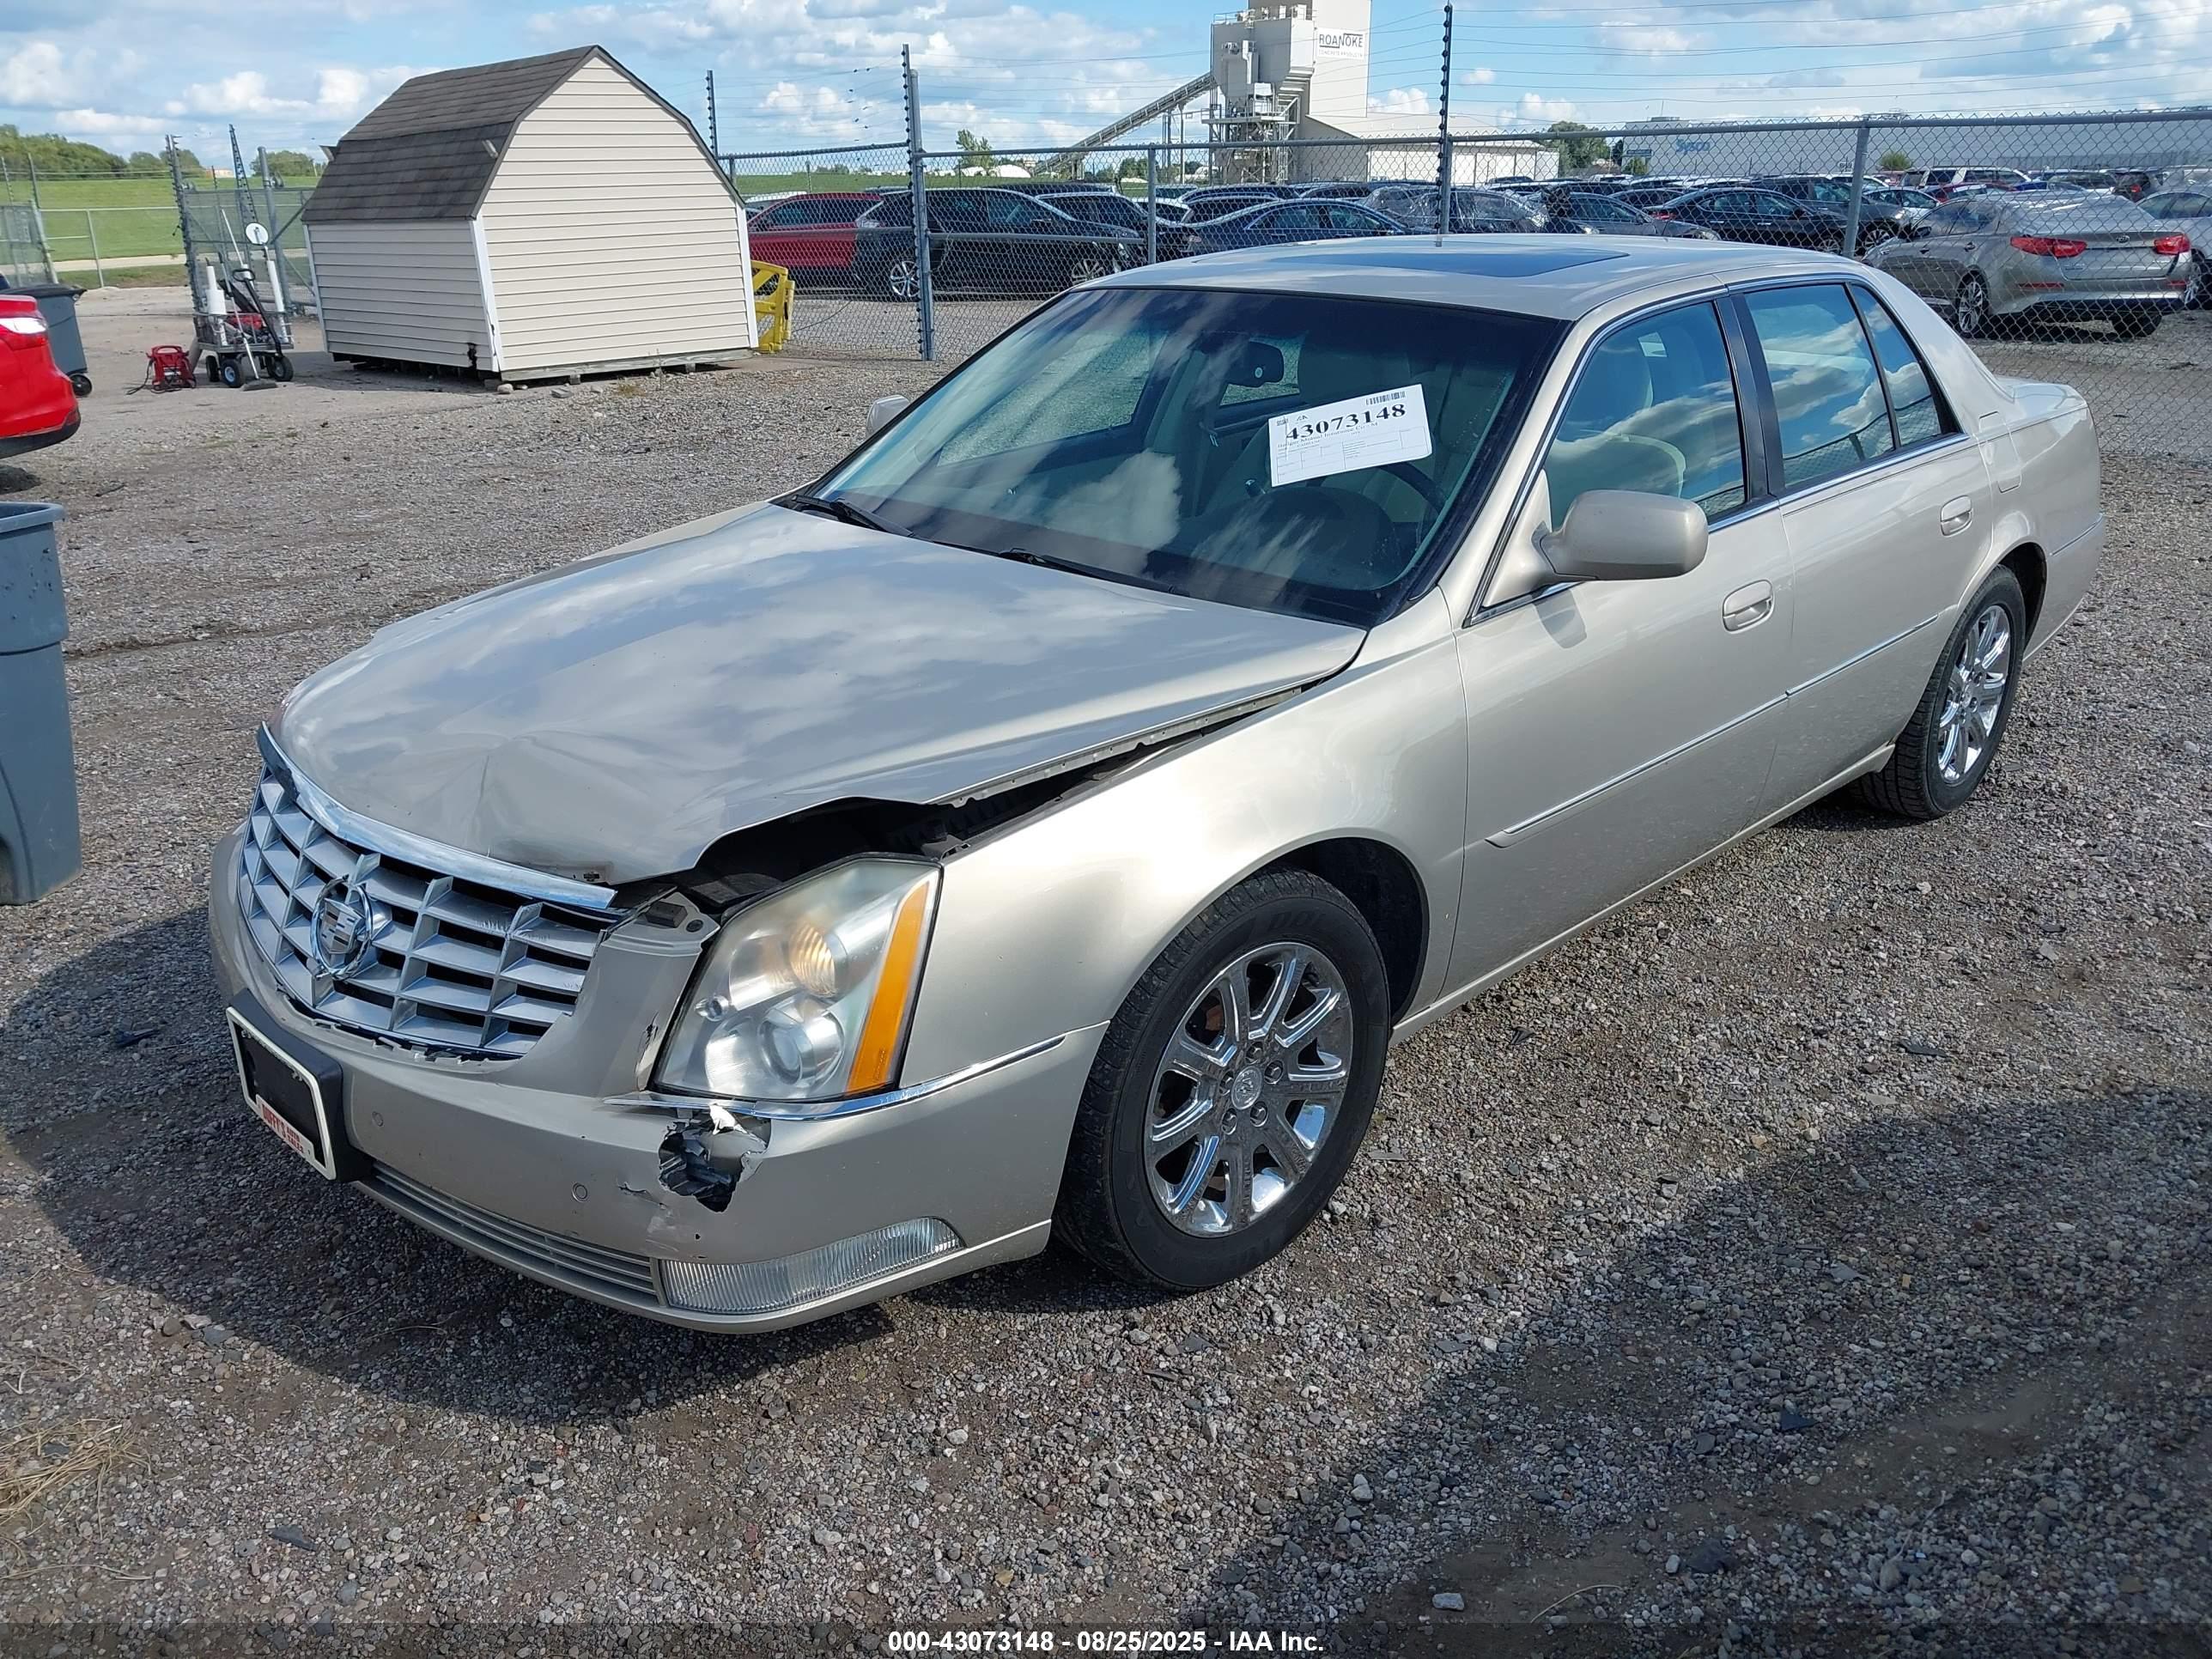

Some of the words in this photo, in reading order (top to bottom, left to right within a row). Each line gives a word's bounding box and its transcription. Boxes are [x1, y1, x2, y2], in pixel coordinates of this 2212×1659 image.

[1319, 33, 1364, 47] ROANOKE
[1675, 138, 1711, 156] Sysco
[1286, 404, 1407, 440] 43073148
